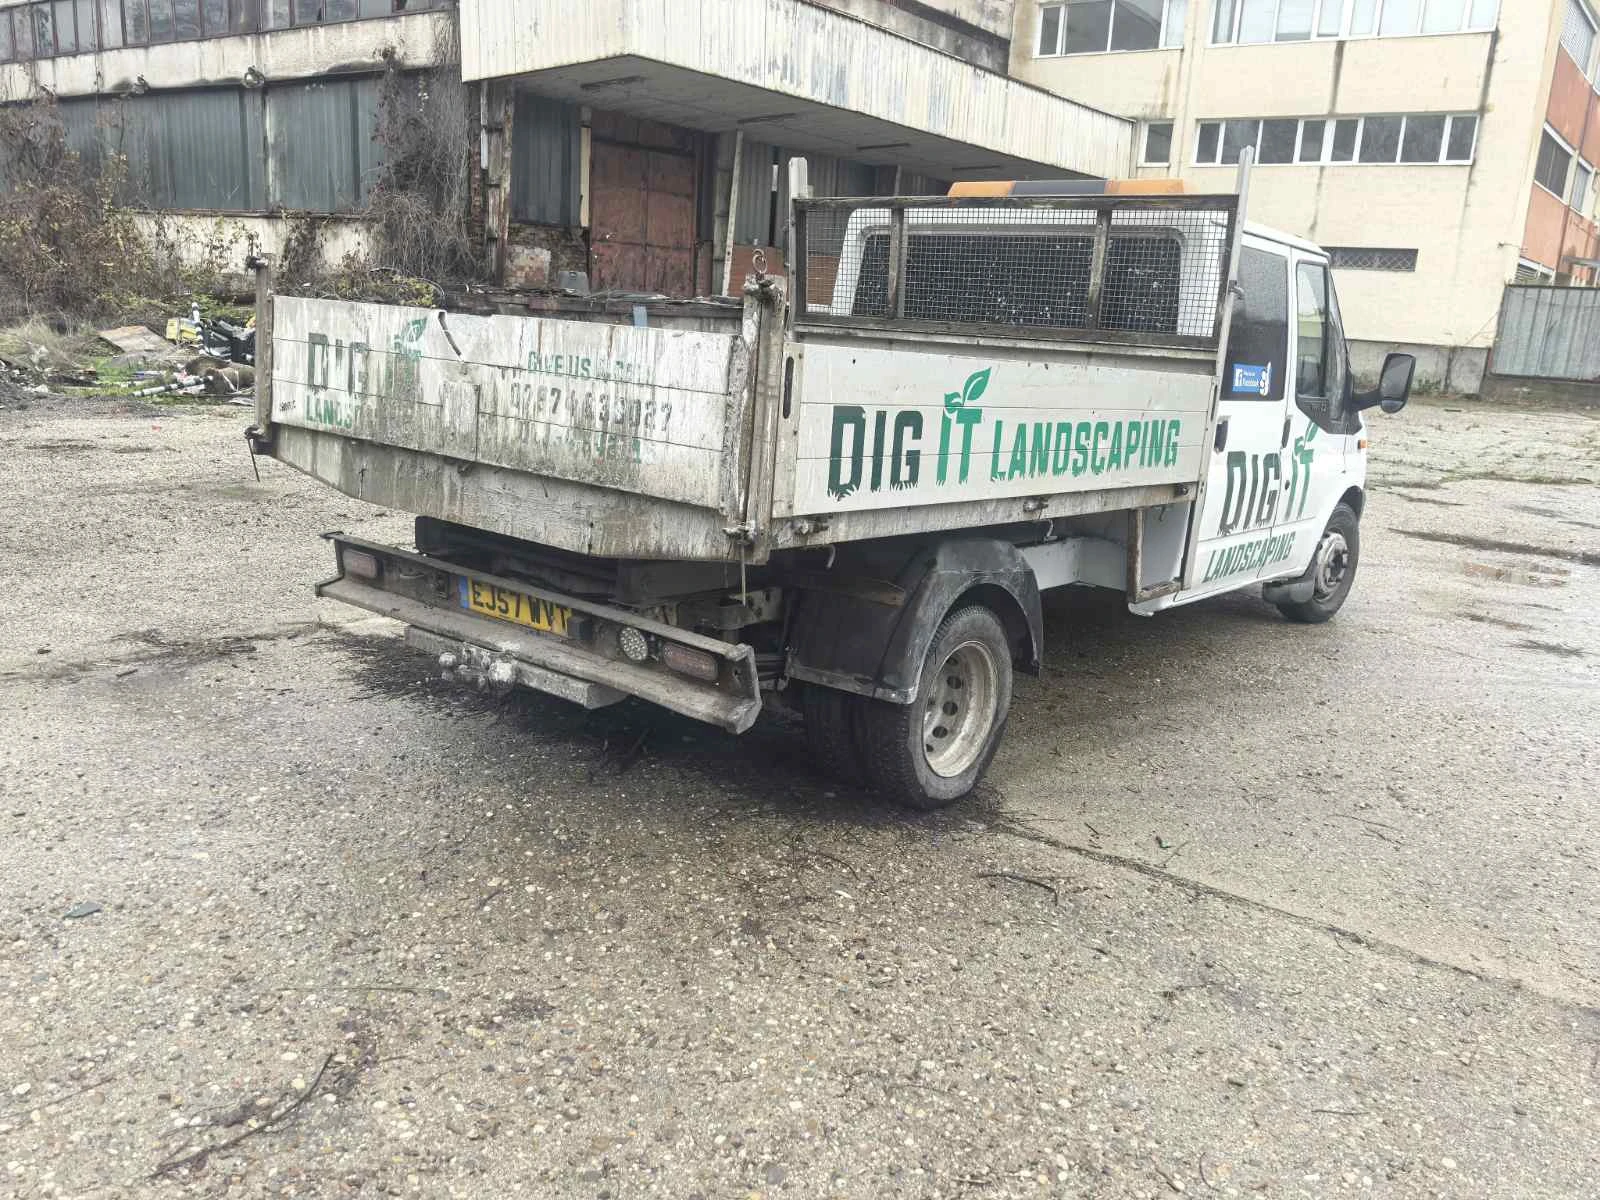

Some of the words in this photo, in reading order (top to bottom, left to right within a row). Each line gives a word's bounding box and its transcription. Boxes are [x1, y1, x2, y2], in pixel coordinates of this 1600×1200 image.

[828, 406, 923, 500] DIG
[936, 405, 982, 486] IT
[990, 419, 1181, 482] LANDSCAPING
[1284, 448, 1314, 521] IT
[1218, 451, 1281, 535] DIG
[1201, 531, 1296, 583] LANDSCAPING
